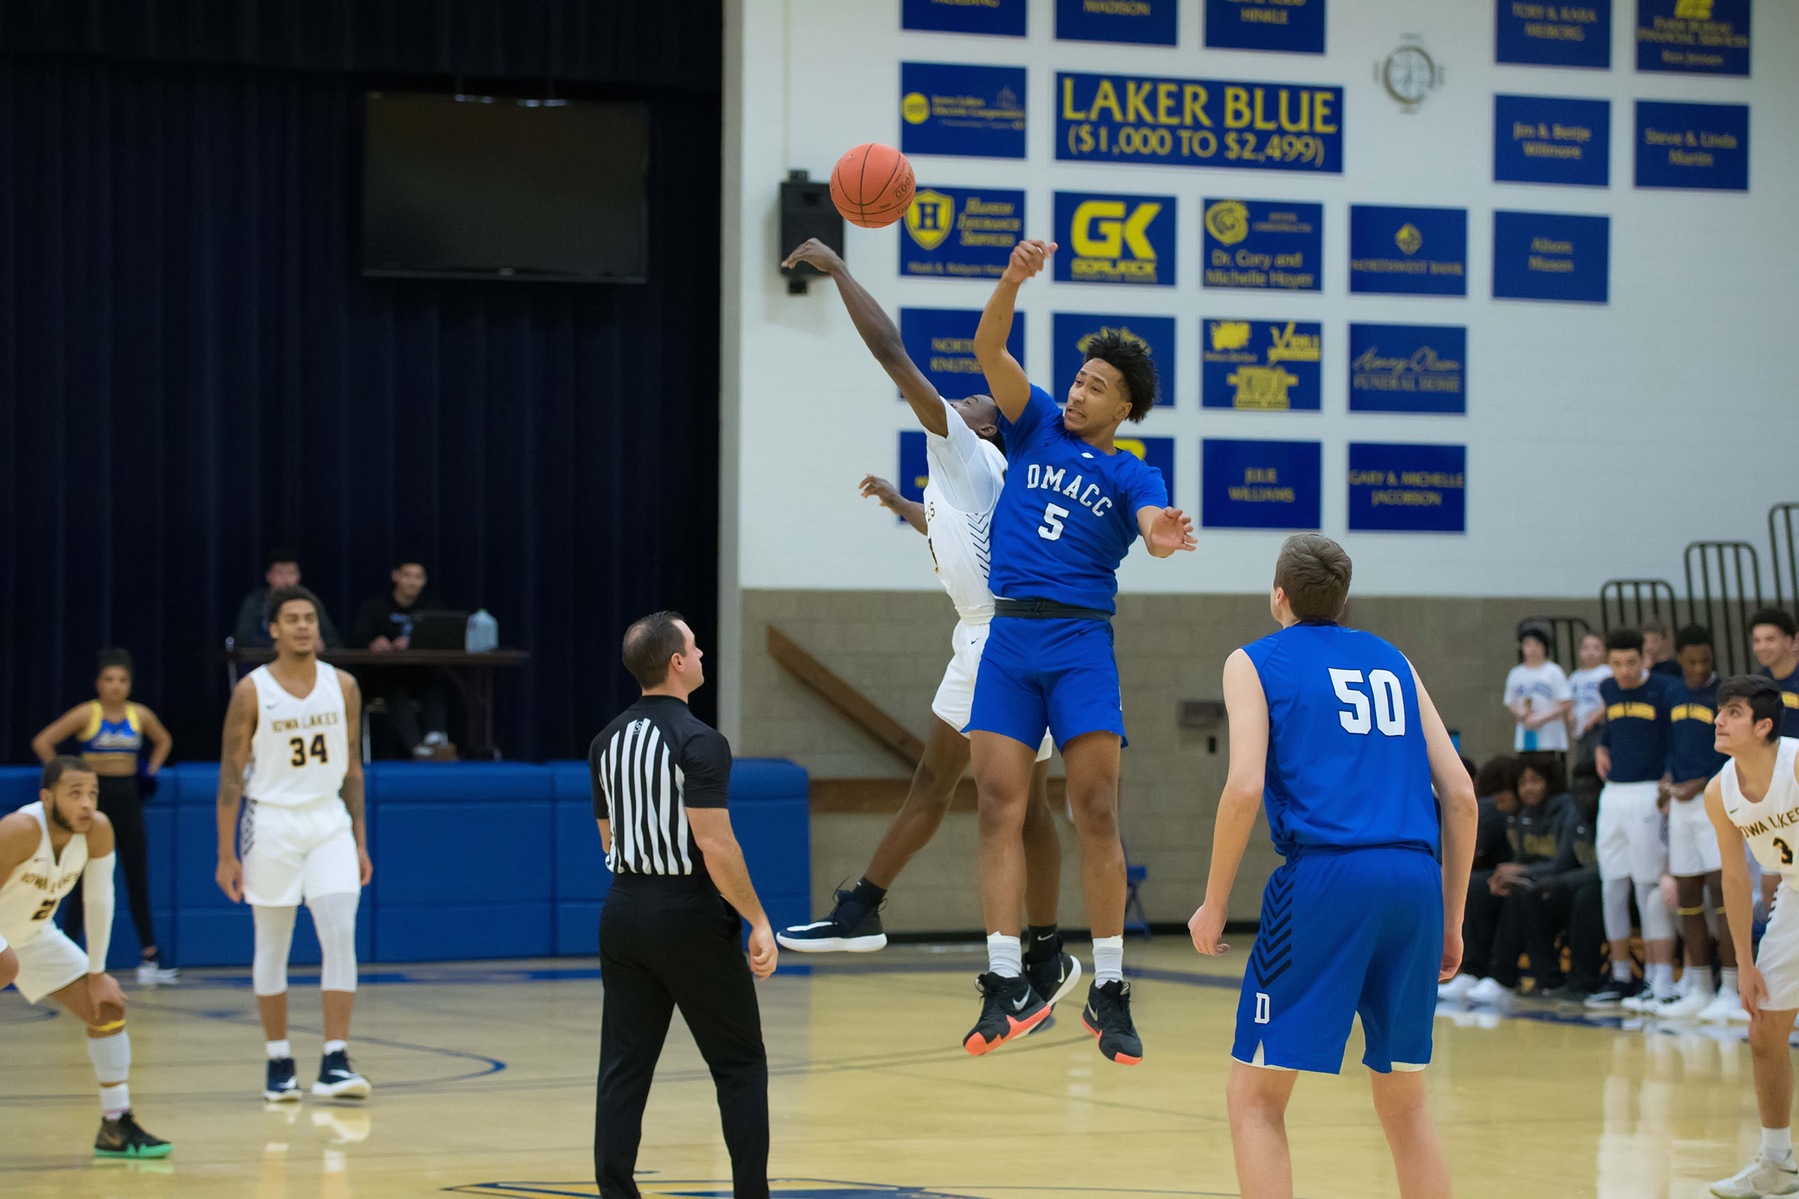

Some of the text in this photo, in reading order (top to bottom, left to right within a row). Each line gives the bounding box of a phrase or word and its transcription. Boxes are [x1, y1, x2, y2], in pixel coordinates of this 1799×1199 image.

[1063, 78, 1337, 133] LAKER BLUE
[1068, 124, 1325, 167] ($1,000 TO $2,499)
[1071, 200, 1161, 258] GK
[1274, 251, 1303, 268] and
[1027, 464, 1113, 517] DMACC
[1038, 502, 1069, 541] 5
[272, 711, 338, 733] IOWA LAKES
[1328, 667, 1406, 736] 50
[290, 733, 328, 768] 34
[1254, 992, 1271, 1024] D
